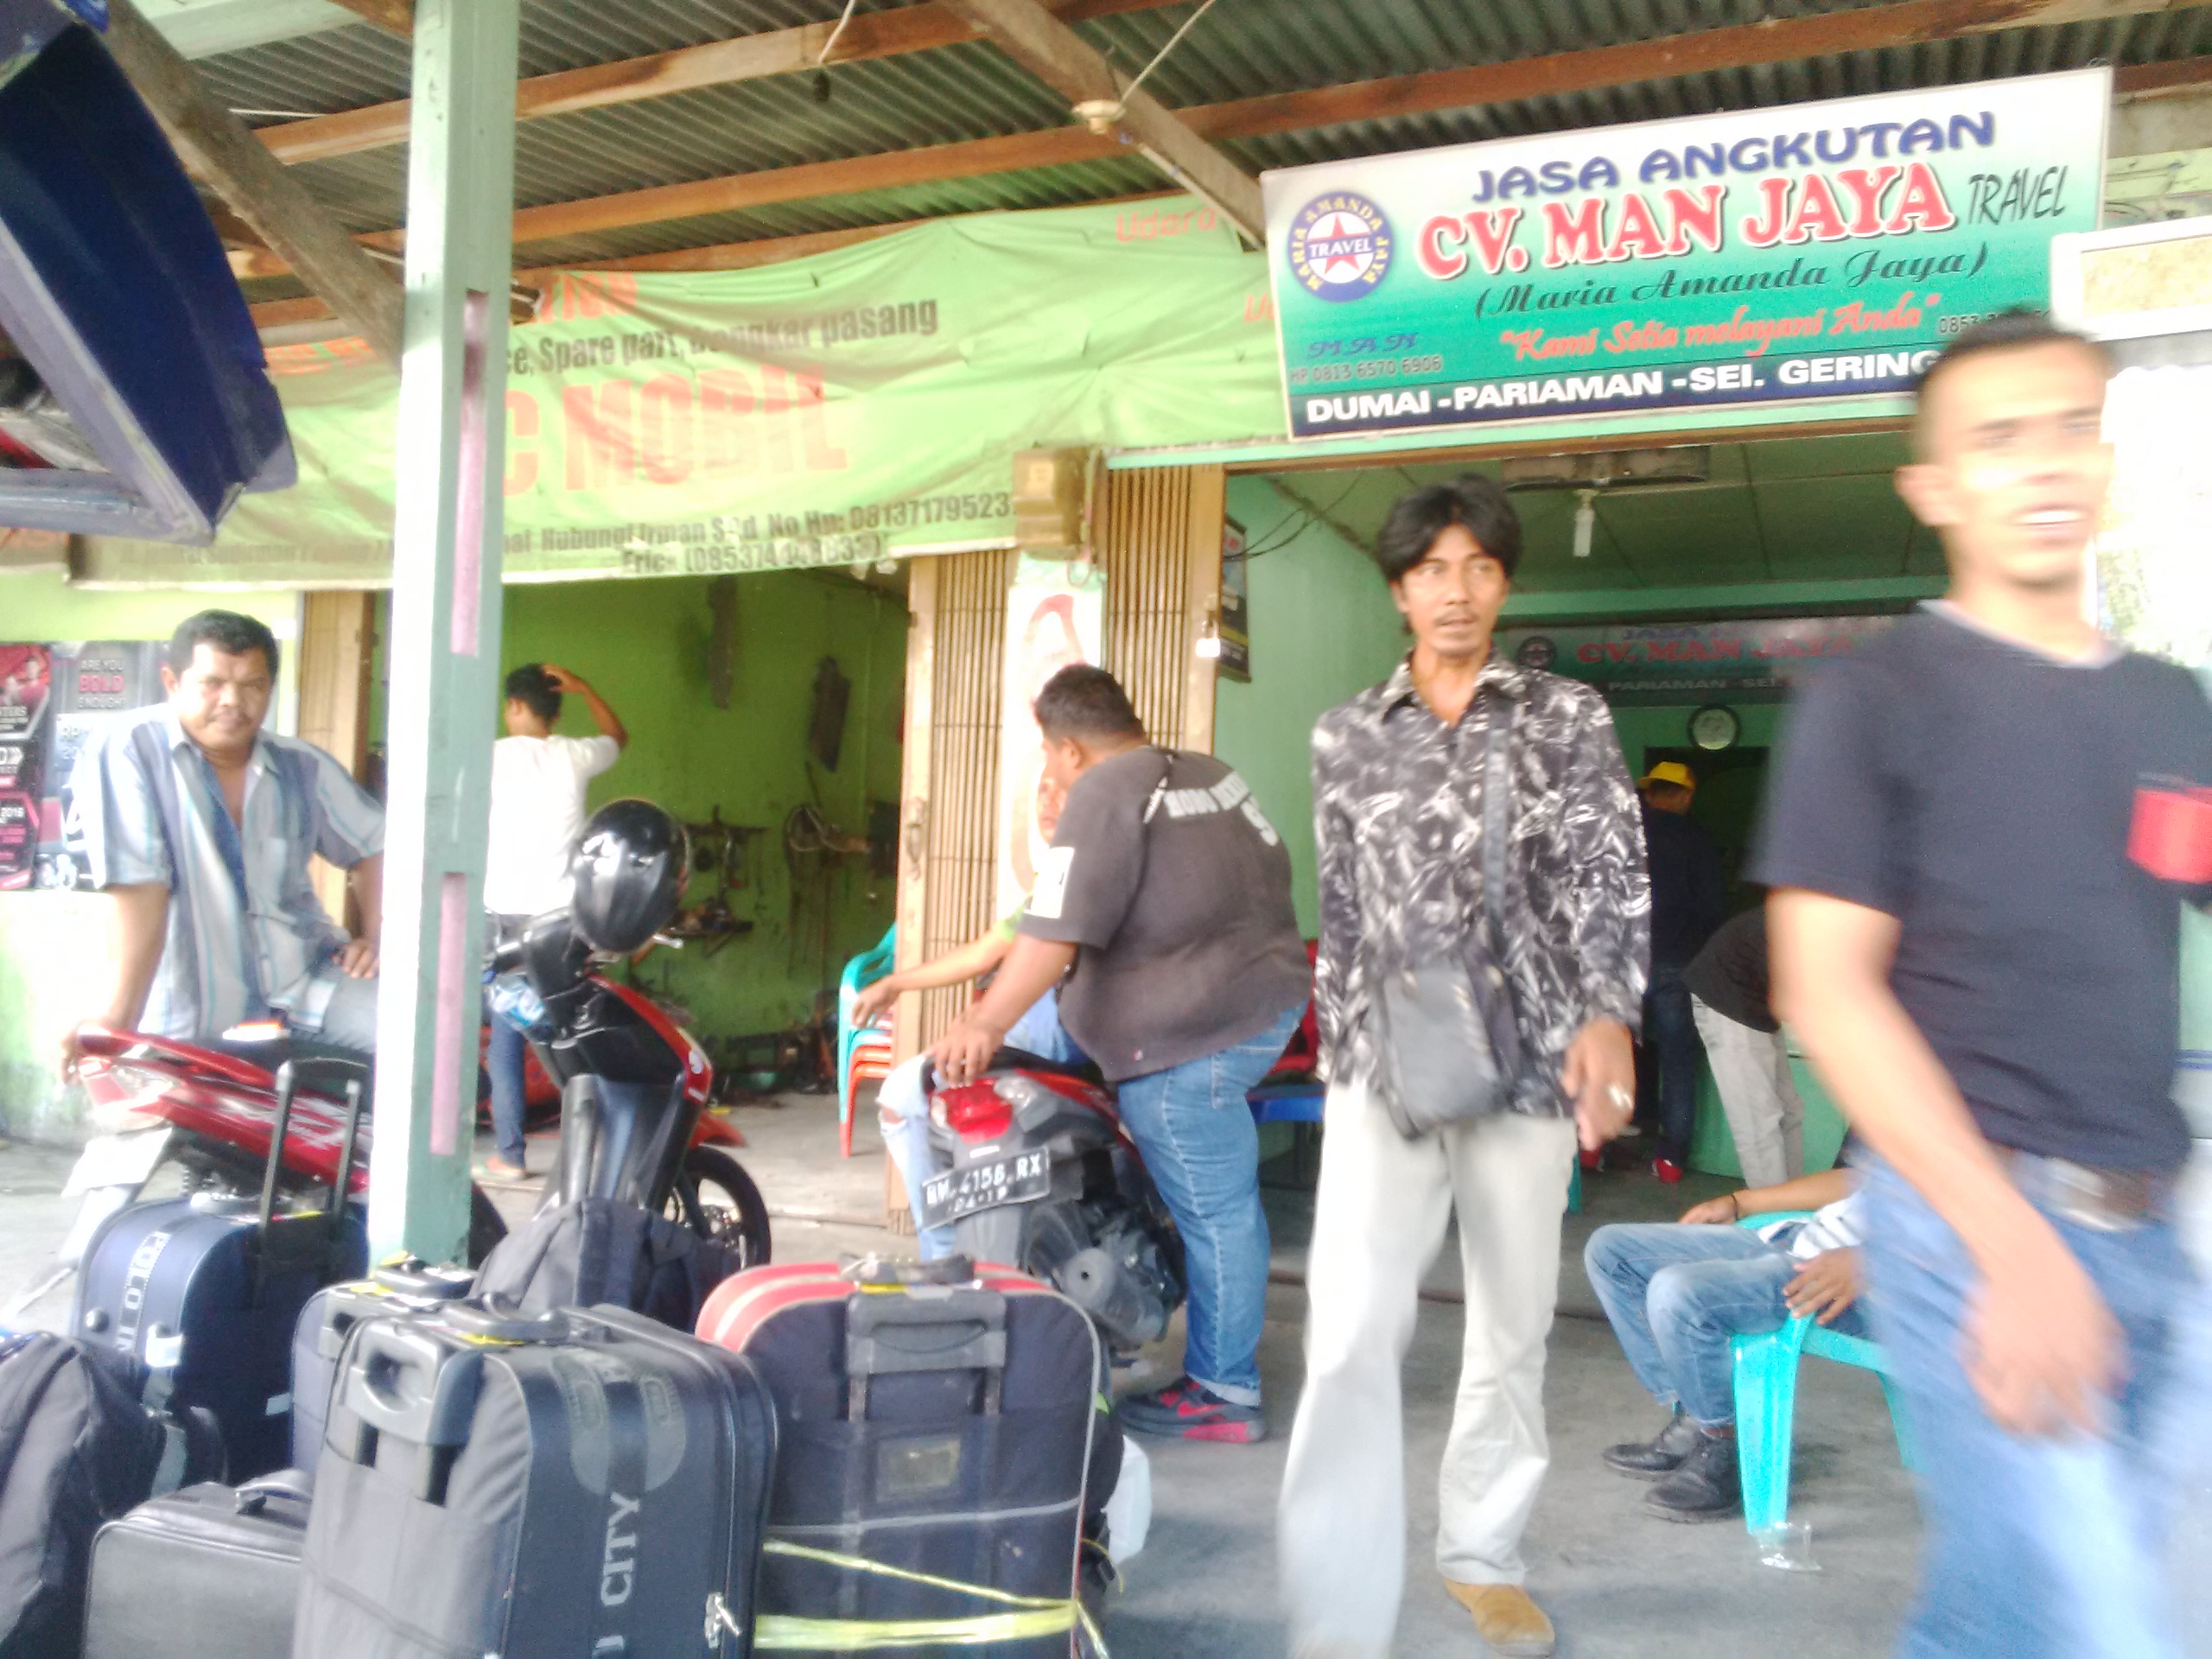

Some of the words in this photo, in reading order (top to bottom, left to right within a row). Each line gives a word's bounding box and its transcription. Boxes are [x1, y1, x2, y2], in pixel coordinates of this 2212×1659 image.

[1472, 156, 1620, 203] JASA
[1639, 111, 1995, 183] ANGKUTAN
[1415, 207, 1529, 279] CV.
[1542, 183, 1726, 268] MAN
[1740, 162, 1955, 247] JAYA
[1967, 165, 2069, 226] TRAVEL
[1309, 238, 1371, 259] TRAVEL
[1630, 257, 1829, 303] Amanda
[538, 335, 615, 373] Spare
[821, 299, 939, 348] pasang
[1603, 320, 1678, 353] Setia
[1685, 304, 1821, 358] melayani
[1313, 362, 1351, 382] 0813
[1357, 358, 1396, 378] 6570
[1402, 353, 1444, 375] 6906
[1306, 390, 1431, 423] DUMAI
[768, 513, 800, 539] No
[1645, 638, 1742, 662] MAN
[79, 674, 124, 693] BOLD
[123, 1230, 173, 1311] POLO
[599, 1491, 640, 1607] CITY
